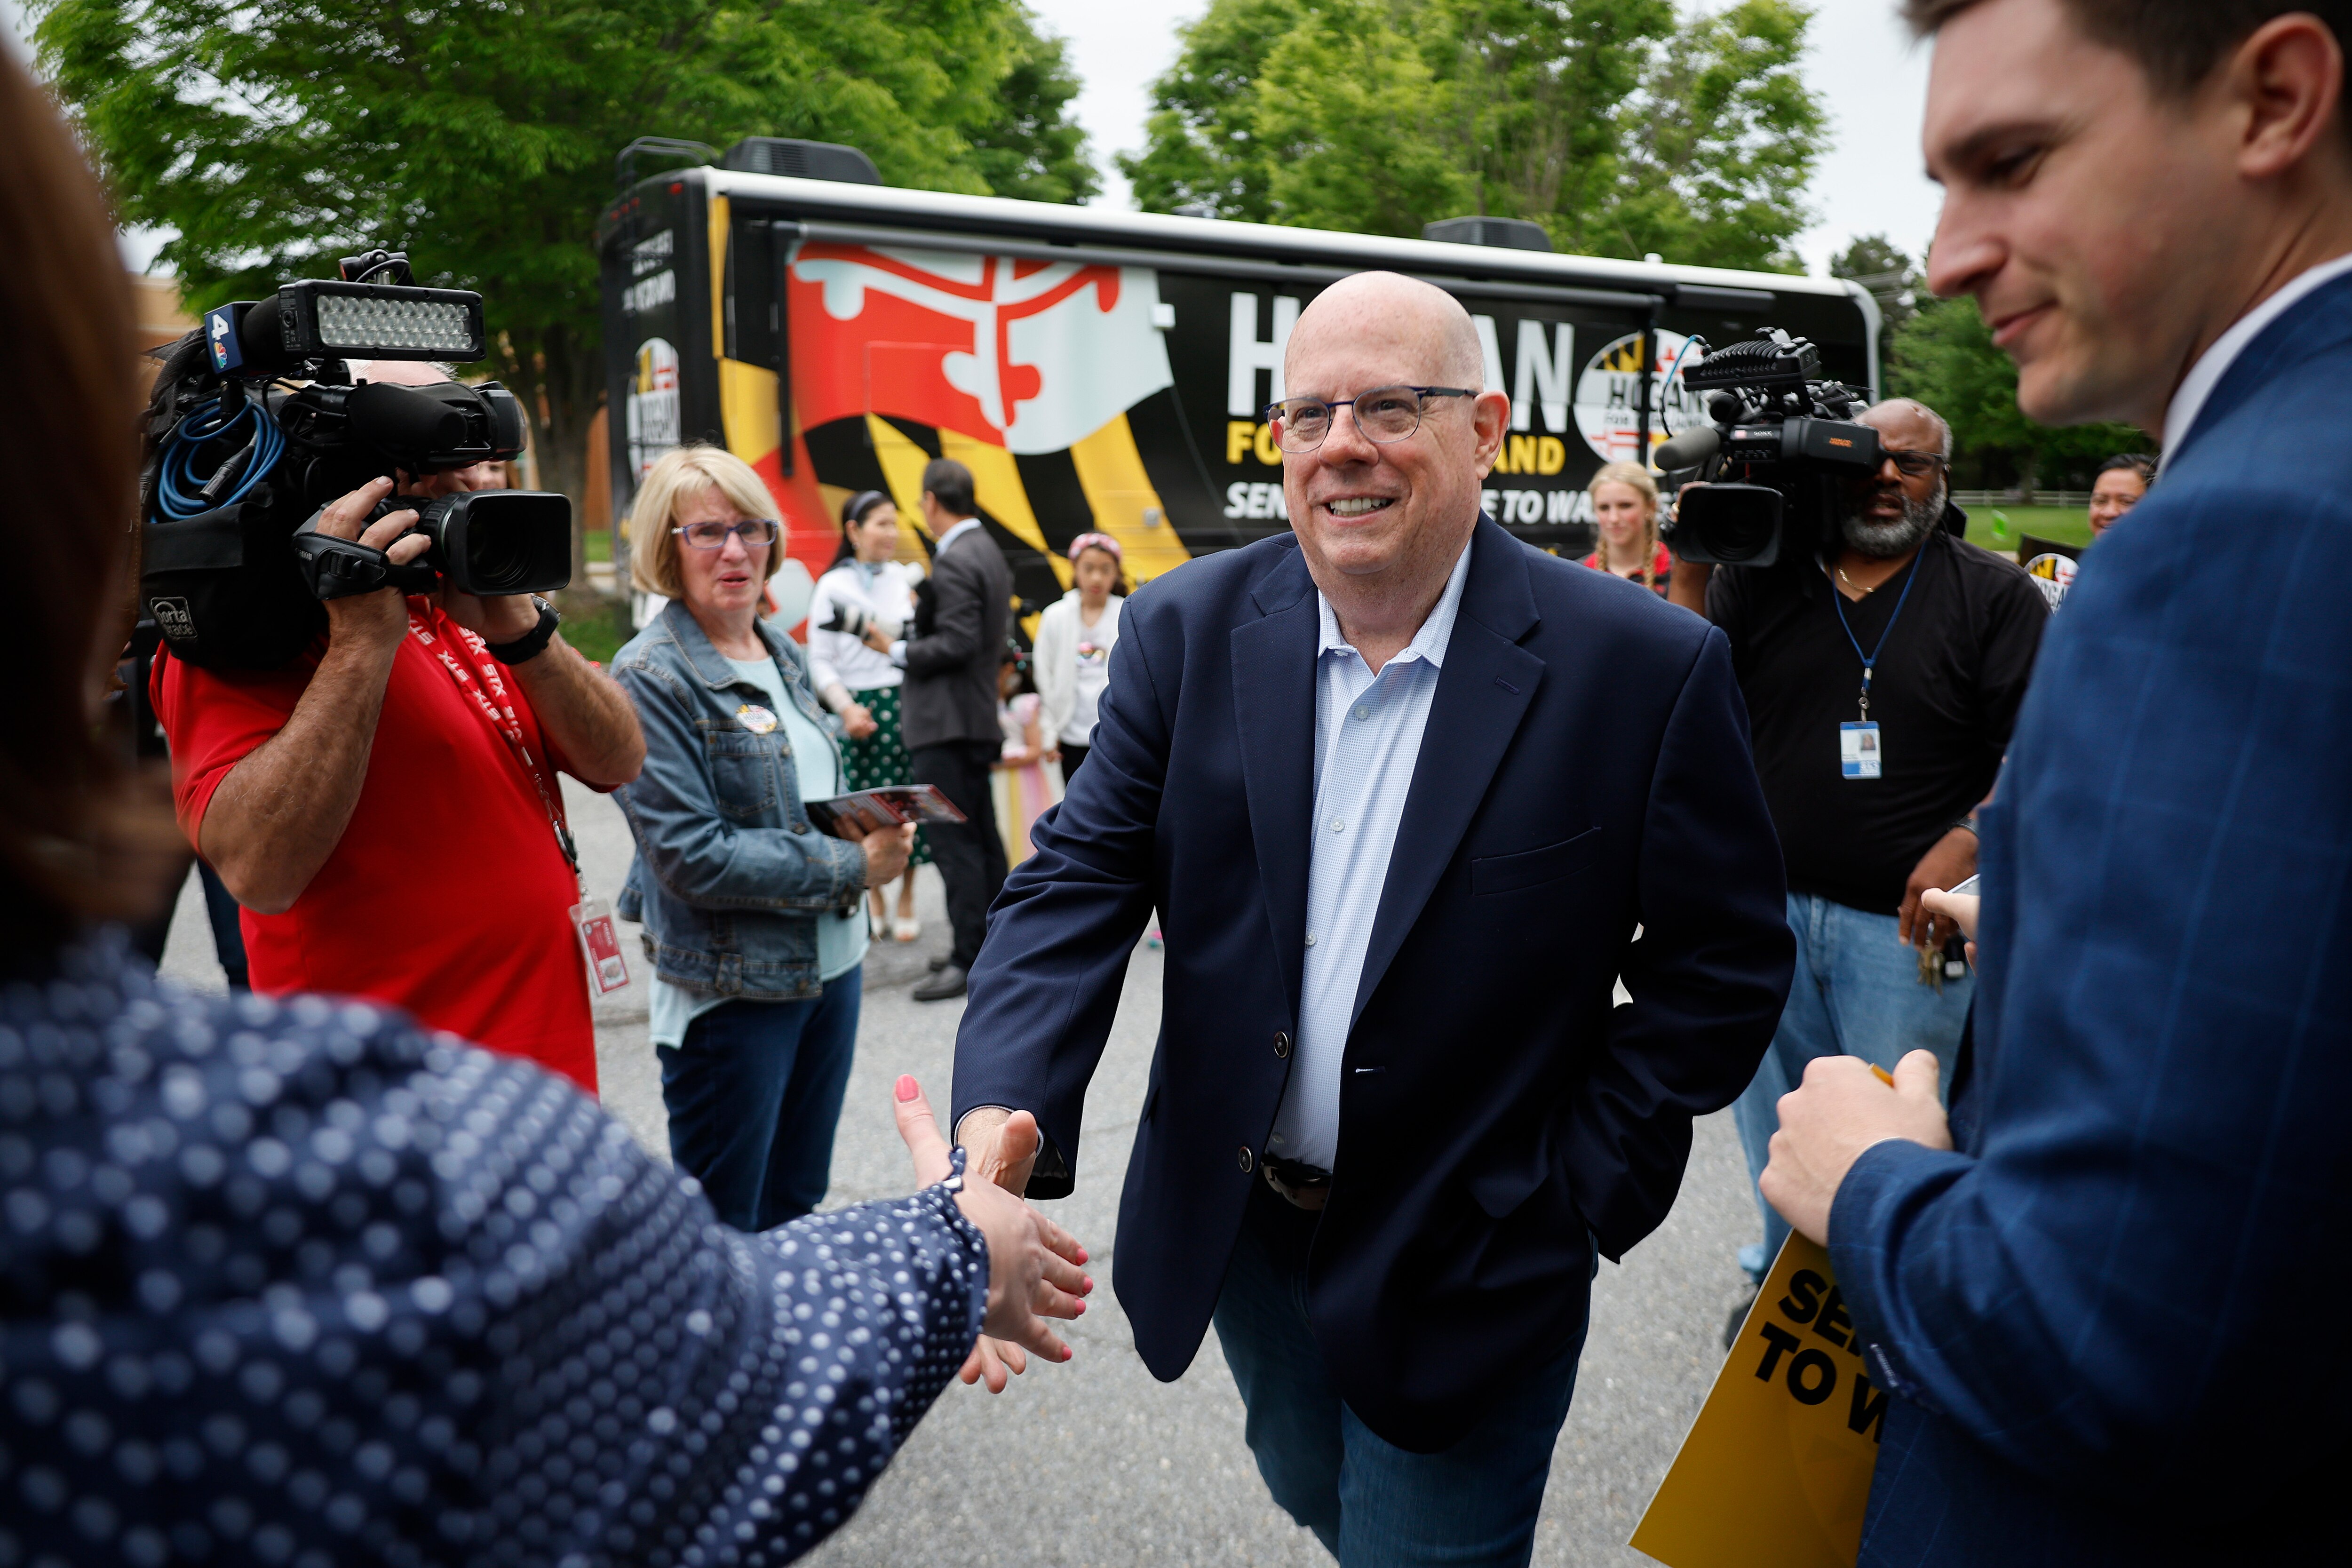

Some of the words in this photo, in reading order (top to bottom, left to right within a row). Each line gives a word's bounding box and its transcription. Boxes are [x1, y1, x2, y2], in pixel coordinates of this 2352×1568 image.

[211, 314, 230, 341] 4
[1227, 291, 1574, 433] HAN
[1226, 421, 1284, 466] FO
[1224, 481, 1289, 520] SEN
[1502, 489, 1545, 525] TO
[1778, 1269, 1866, 1358] SE
[1755, 1321, 1837, 1406] TO
